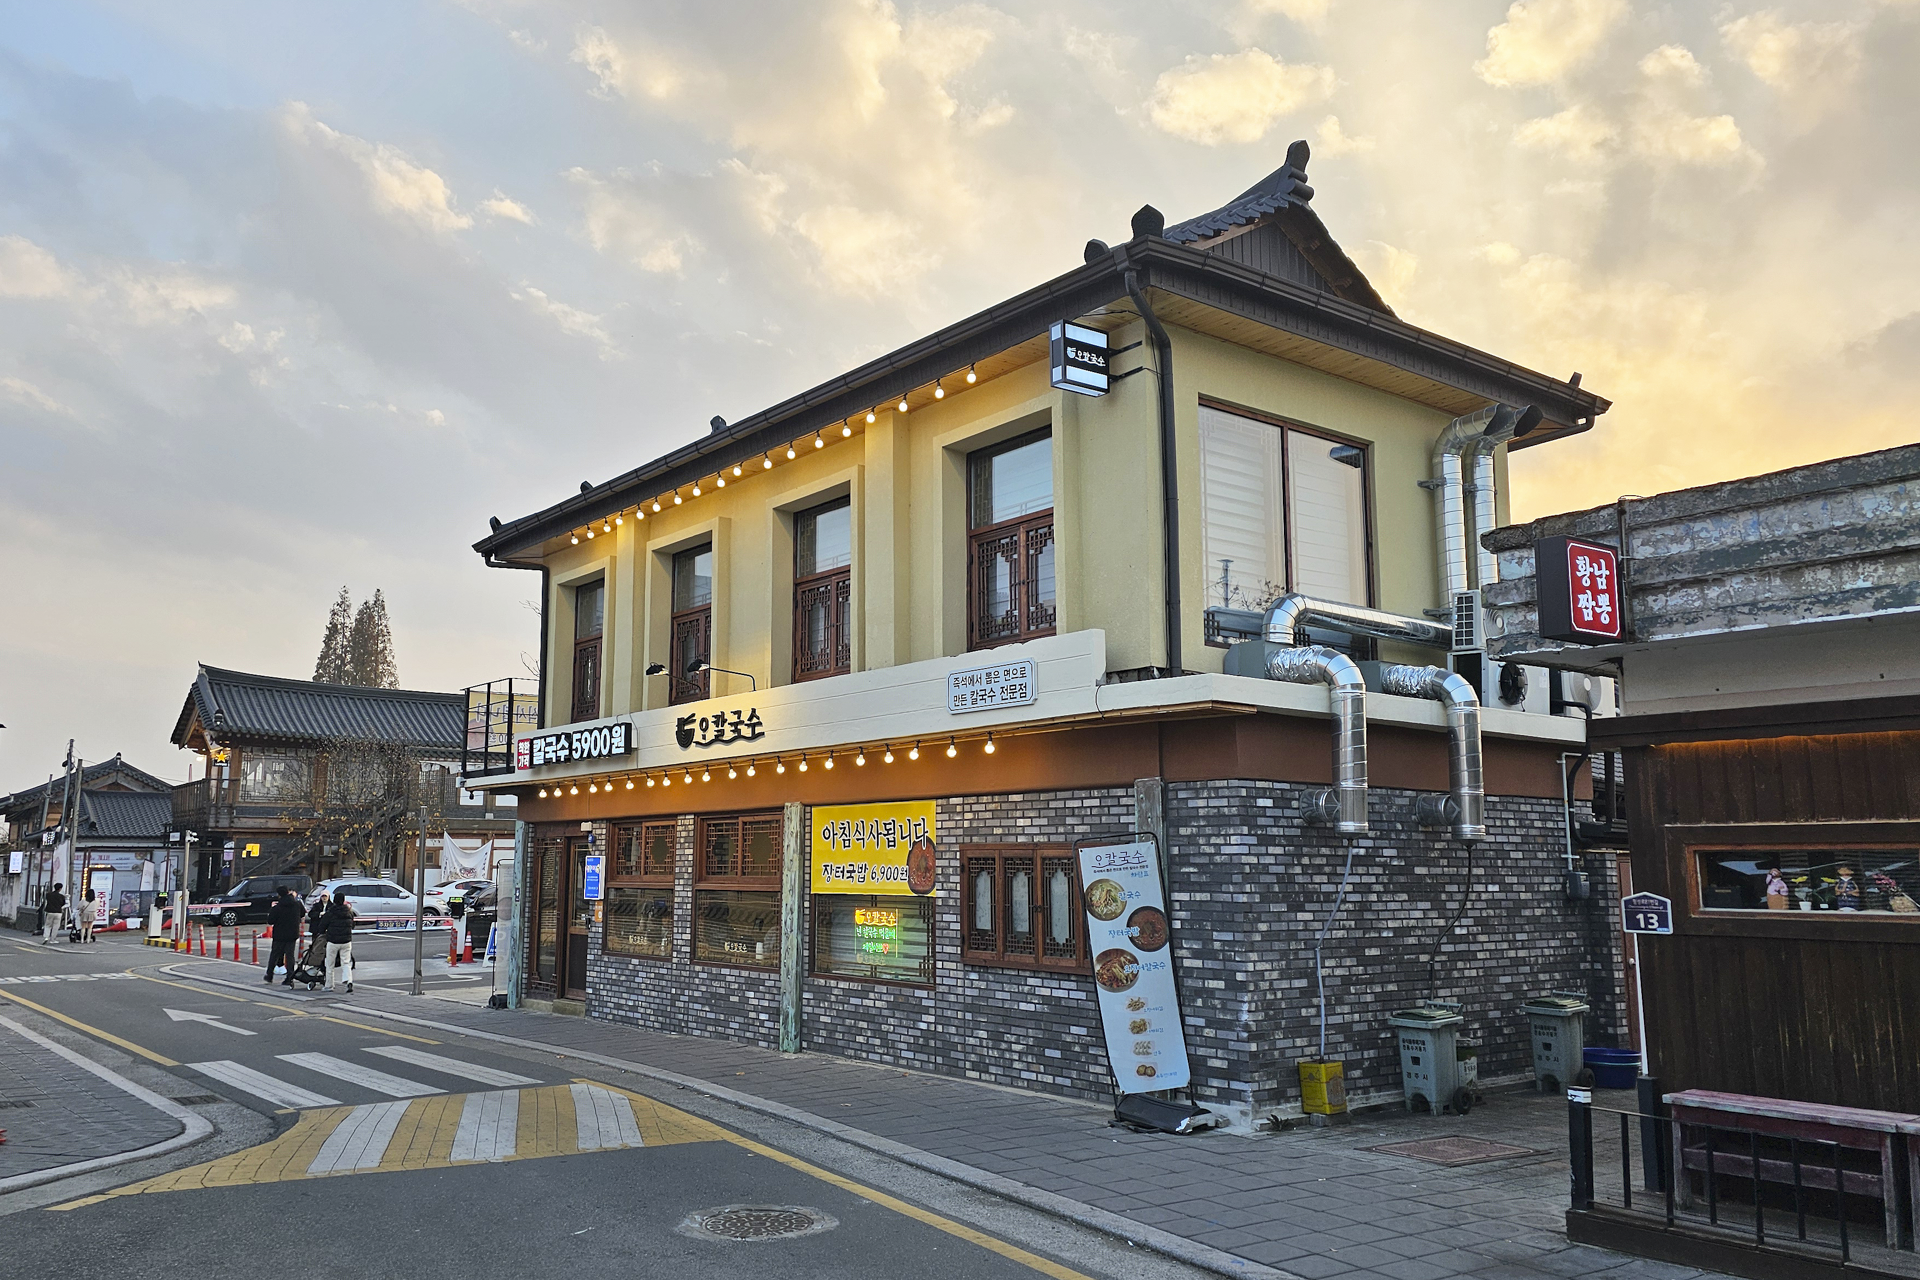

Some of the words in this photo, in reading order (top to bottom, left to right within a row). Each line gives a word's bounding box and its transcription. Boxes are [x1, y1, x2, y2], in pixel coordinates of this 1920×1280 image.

[1576, 556, 1610, 590] 황남
[1577, 589, 1612, 625] 짬뽕
[953, 673, 982, 689] 즉석에서
[985, 670, 1001, 685] 뽑은
[1003, 666, 1027, 682] 면으로
[953, 693, 968, 707] 만든
[970, 687, 996, 706] 칼국수
[1000, 682, 1028, 700] 전문점
[698, 708, 765, 746] 오칼국수
[533, 735, 570, 765] 칼국수
[572, 725, 626, 760] 5900원
[518, 754, 530, 768] 가격
[822, 817, 929, 850] 아침식사됩니다
[1093, 850, 1146, 867] 오칼국수
[822, 863, 869, 883] 장터국밥
[870, 866, 908, 884] 6,900원
[1118, 890, 1141, 900] 칼국수
[866, 910, 897, 926] 오칼국수
[1635, 913, 1659, 929] 13
[1108, 926, 1140, 938] 장터국밥
